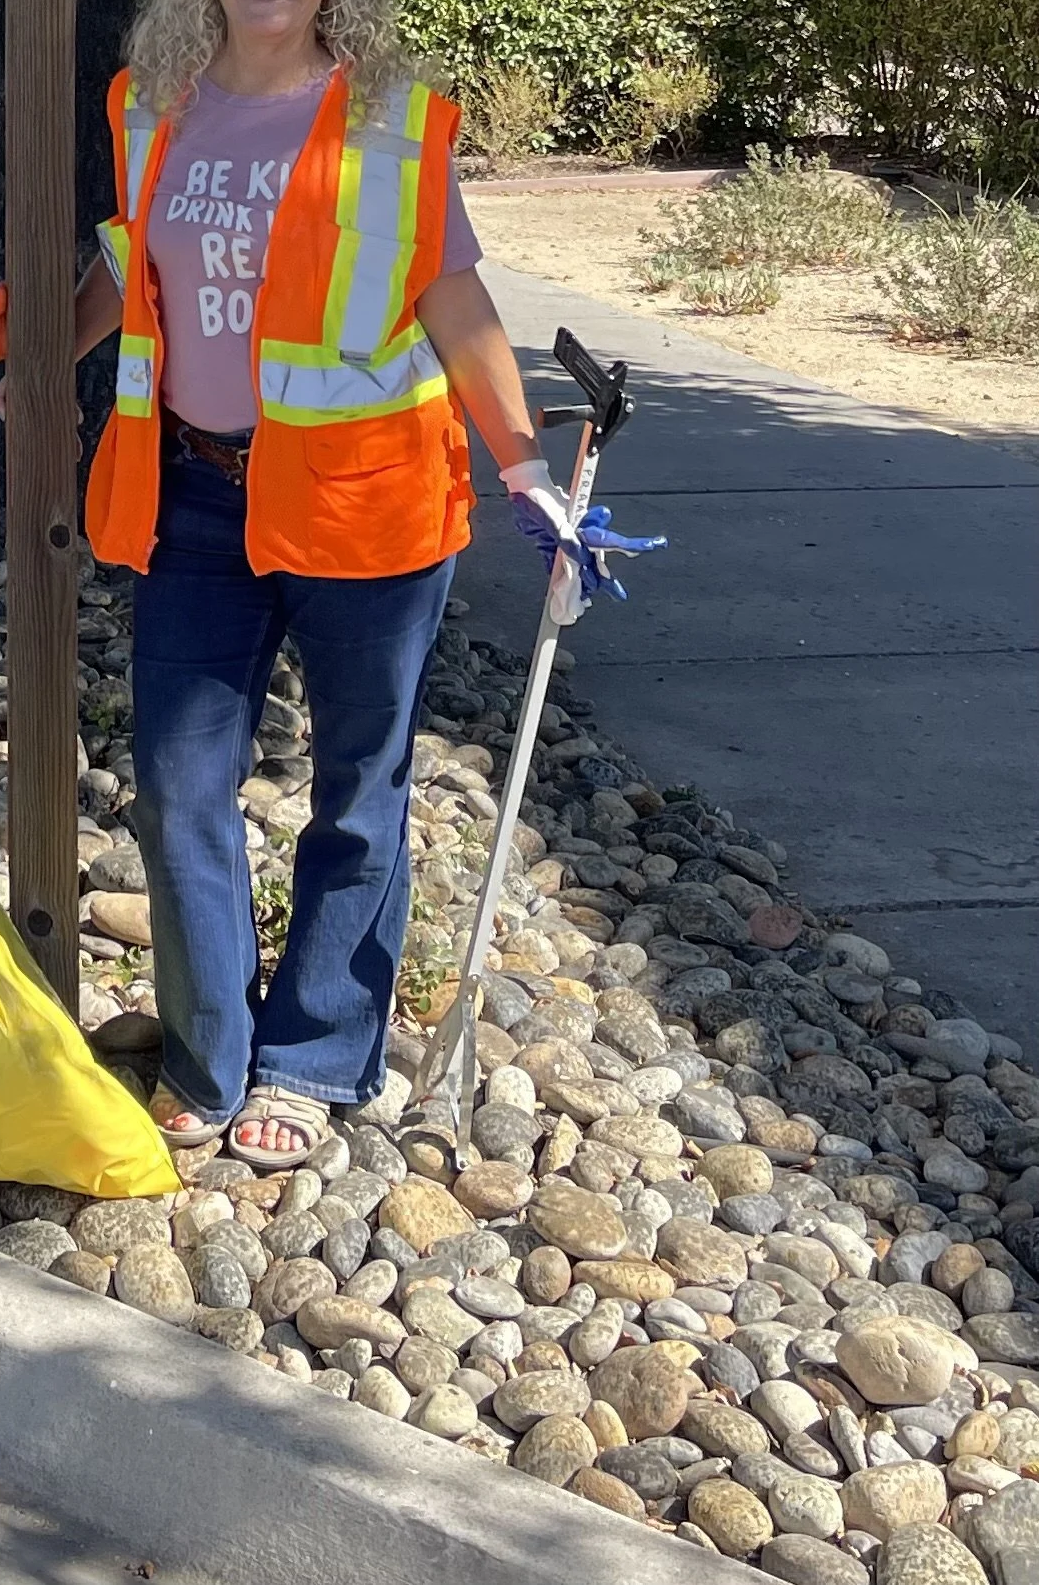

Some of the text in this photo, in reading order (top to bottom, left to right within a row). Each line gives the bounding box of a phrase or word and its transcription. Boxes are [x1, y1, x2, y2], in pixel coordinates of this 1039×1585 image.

[184, 160, 233, 199] BE
[166, 195, 253, 232] DRINK
[201, 231, 266, 280] RE
